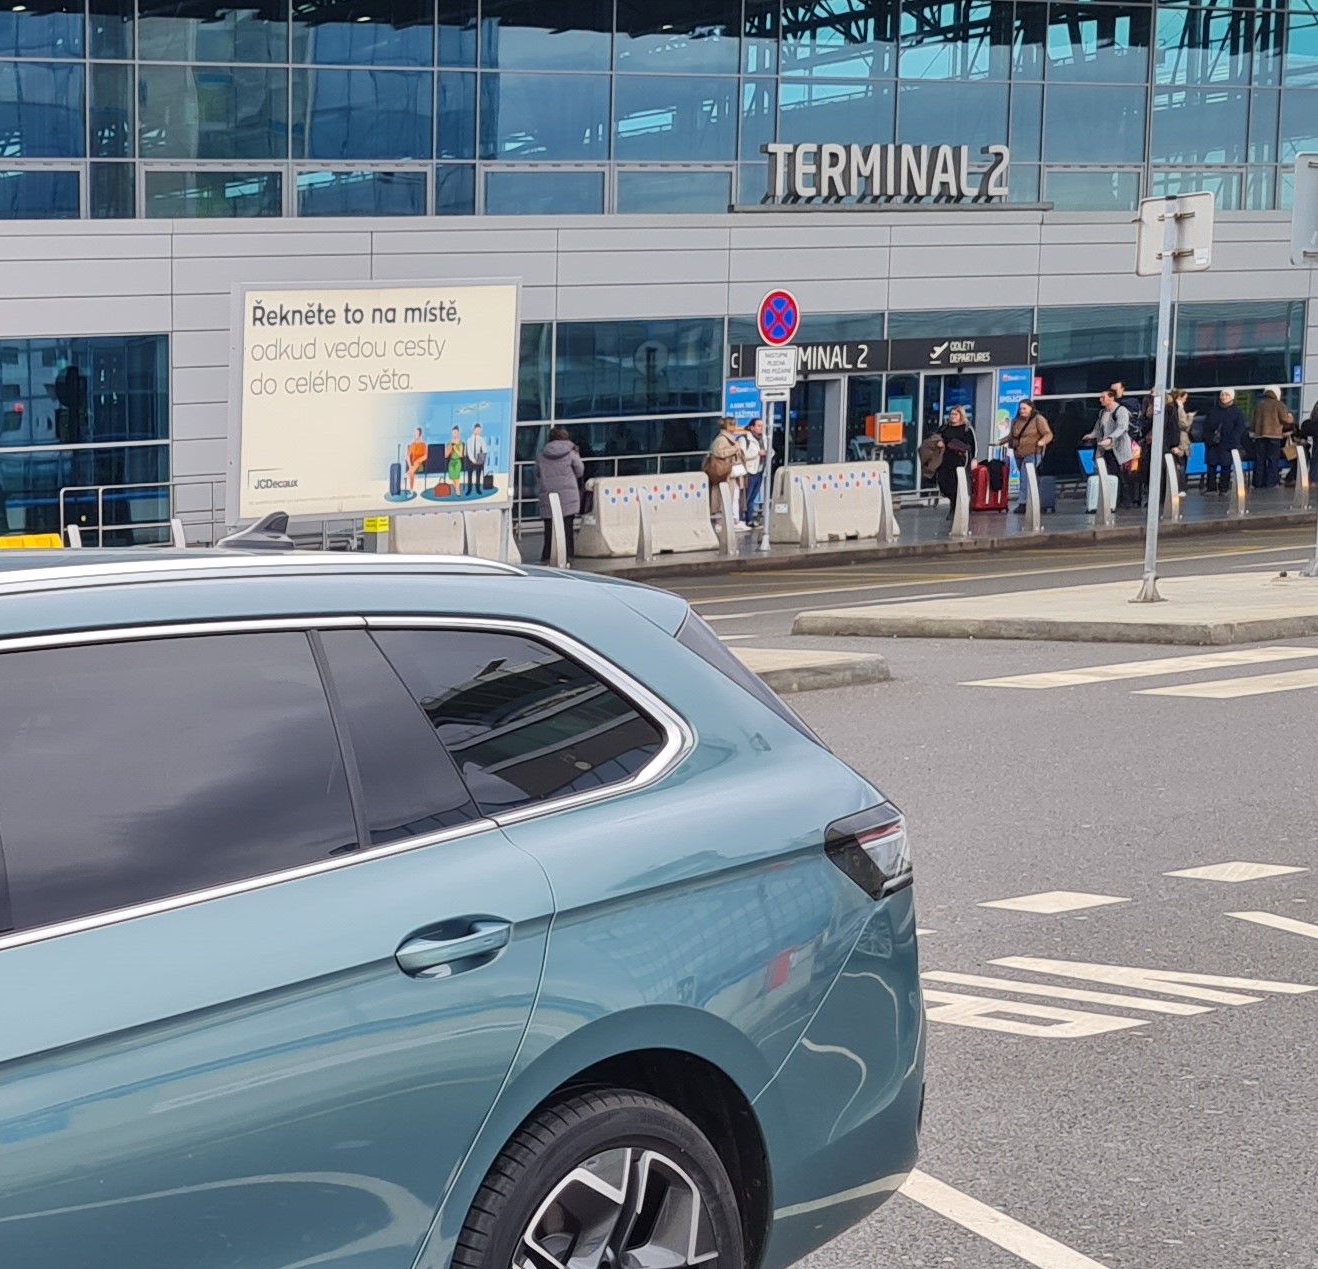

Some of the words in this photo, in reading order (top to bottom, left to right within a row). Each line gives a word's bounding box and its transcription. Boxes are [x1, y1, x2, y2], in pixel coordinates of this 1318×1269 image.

[764, 143, 981, 197] TERMINAL
[985, 144, 1010, 196] 2
[252, 299, 337, 327] Řekněte
[344, 303, 364, 325] to
[371, 307, 397, 324] na
[404, 299, 462, 326] místě,
[250, 336, 317, 362] odkud
[324, 336, 386, 360] vedou
[393, 334, 446, 361] cesty
[797, 345, 853, 370] MINAL
[857, 344, 868, 369] 2
[949, 340, 976, 352] ODLETY
[949, 351, 991, 363] DEPARTURES
[730, 353, 739, 370] C
[250, 372, 277, 396] do
[284, 370, 351, 394] celého
[357, 368, 414, 392] světa.
[254, 479, 299, 490] JCDecaux
